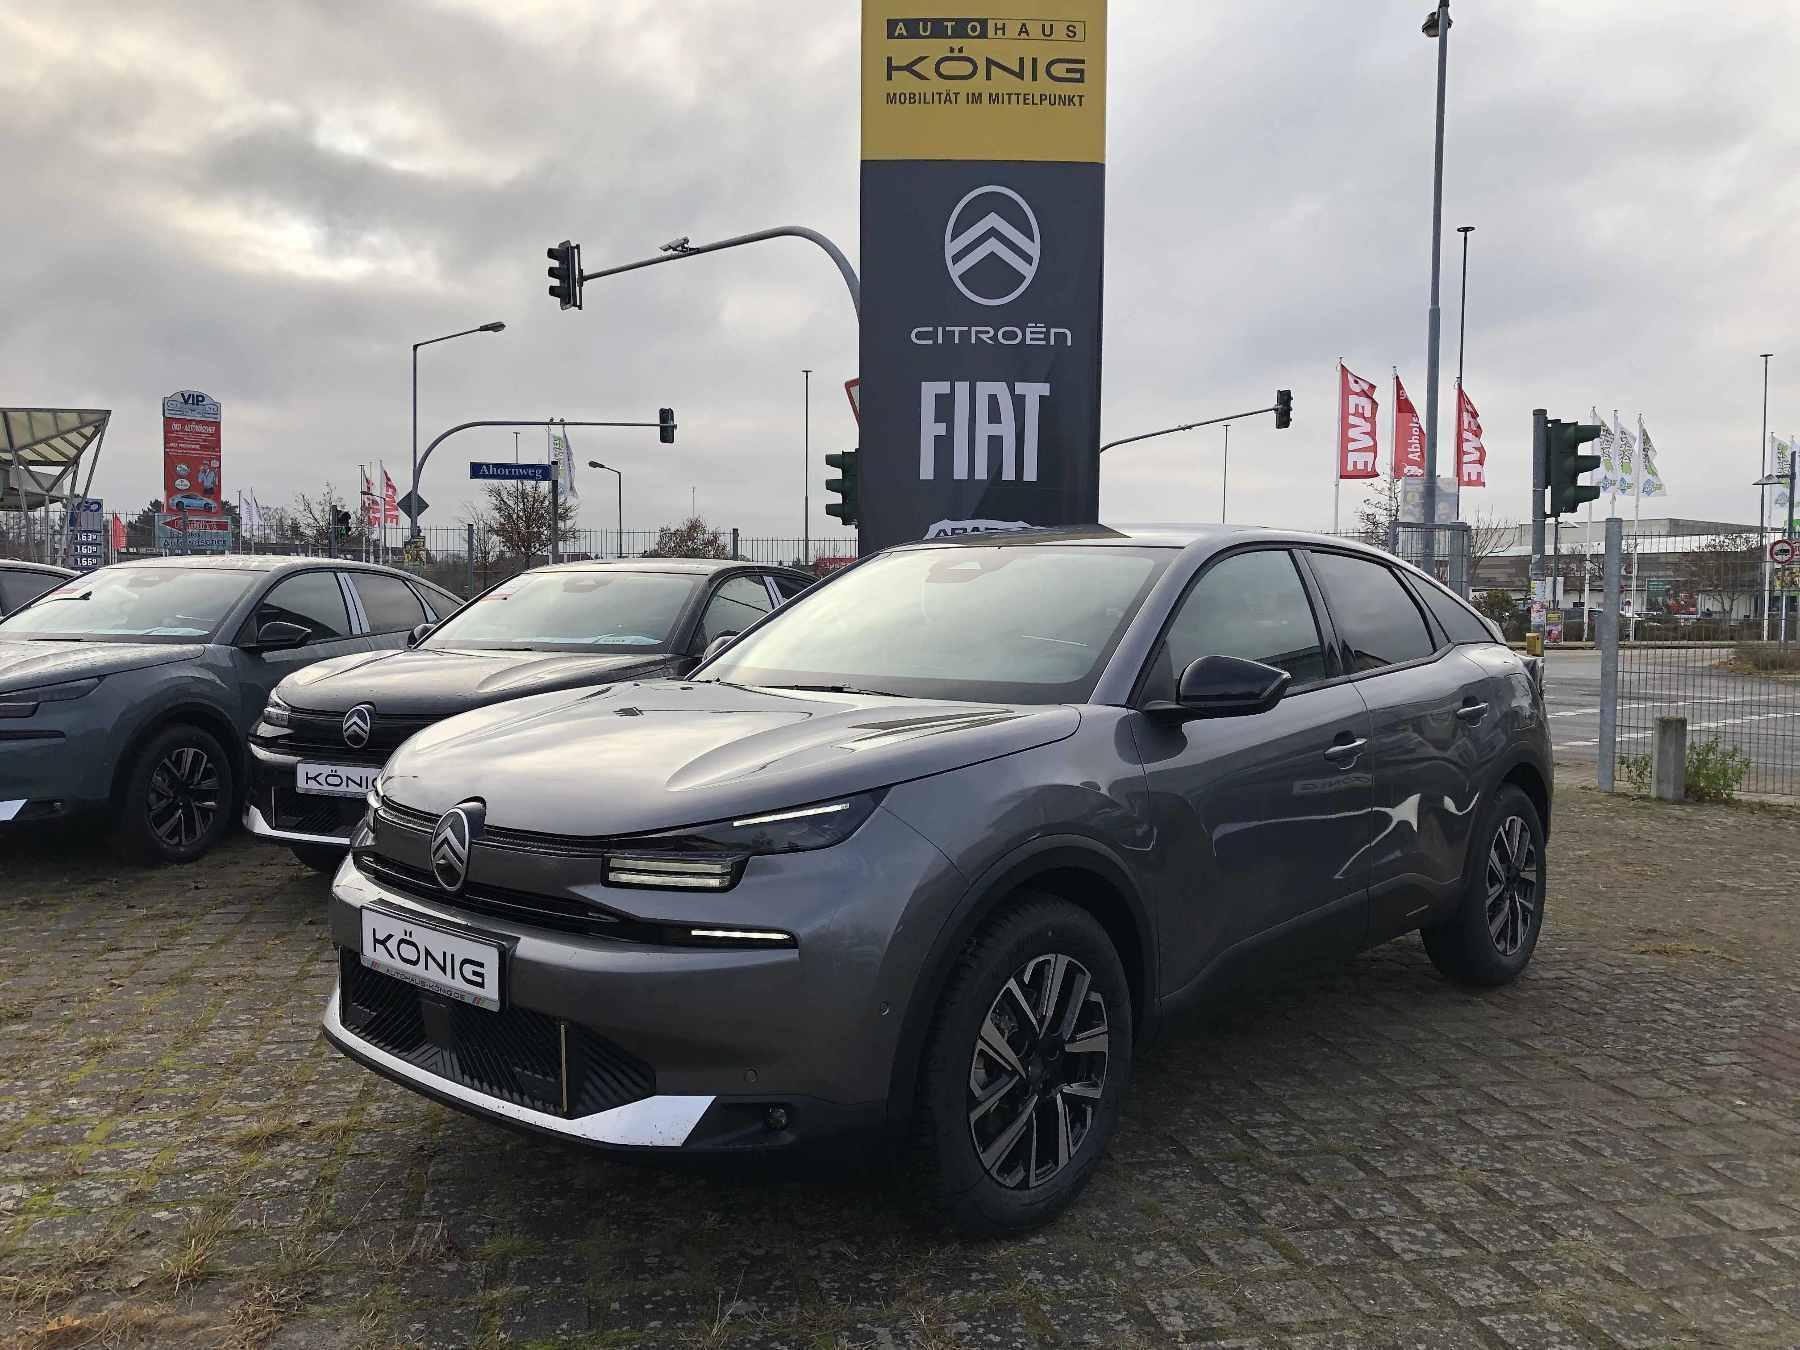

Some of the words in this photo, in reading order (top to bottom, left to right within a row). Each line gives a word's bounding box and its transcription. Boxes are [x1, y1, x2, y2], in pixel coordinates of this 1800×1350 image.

[894, 20, 1078, 38] AUTOHAUS
[886, 46, 1086, 83] KÖNIG
[886, 89, 960, 105] MOBILITÄT
[966, 91, 983, 105] IM
[988, 92, 1085, 107] MITTELPUNKT
[180, 392, 206, 406] VIP
[919, 380, 1051, 482] FIAT
[1347, 371, 1375, 472] REWE
[1463, 396, 1485, 481] EWE
[480, 464, 542, 480] Ahornweg
[372, 927, 486, 990] KÖNIG
